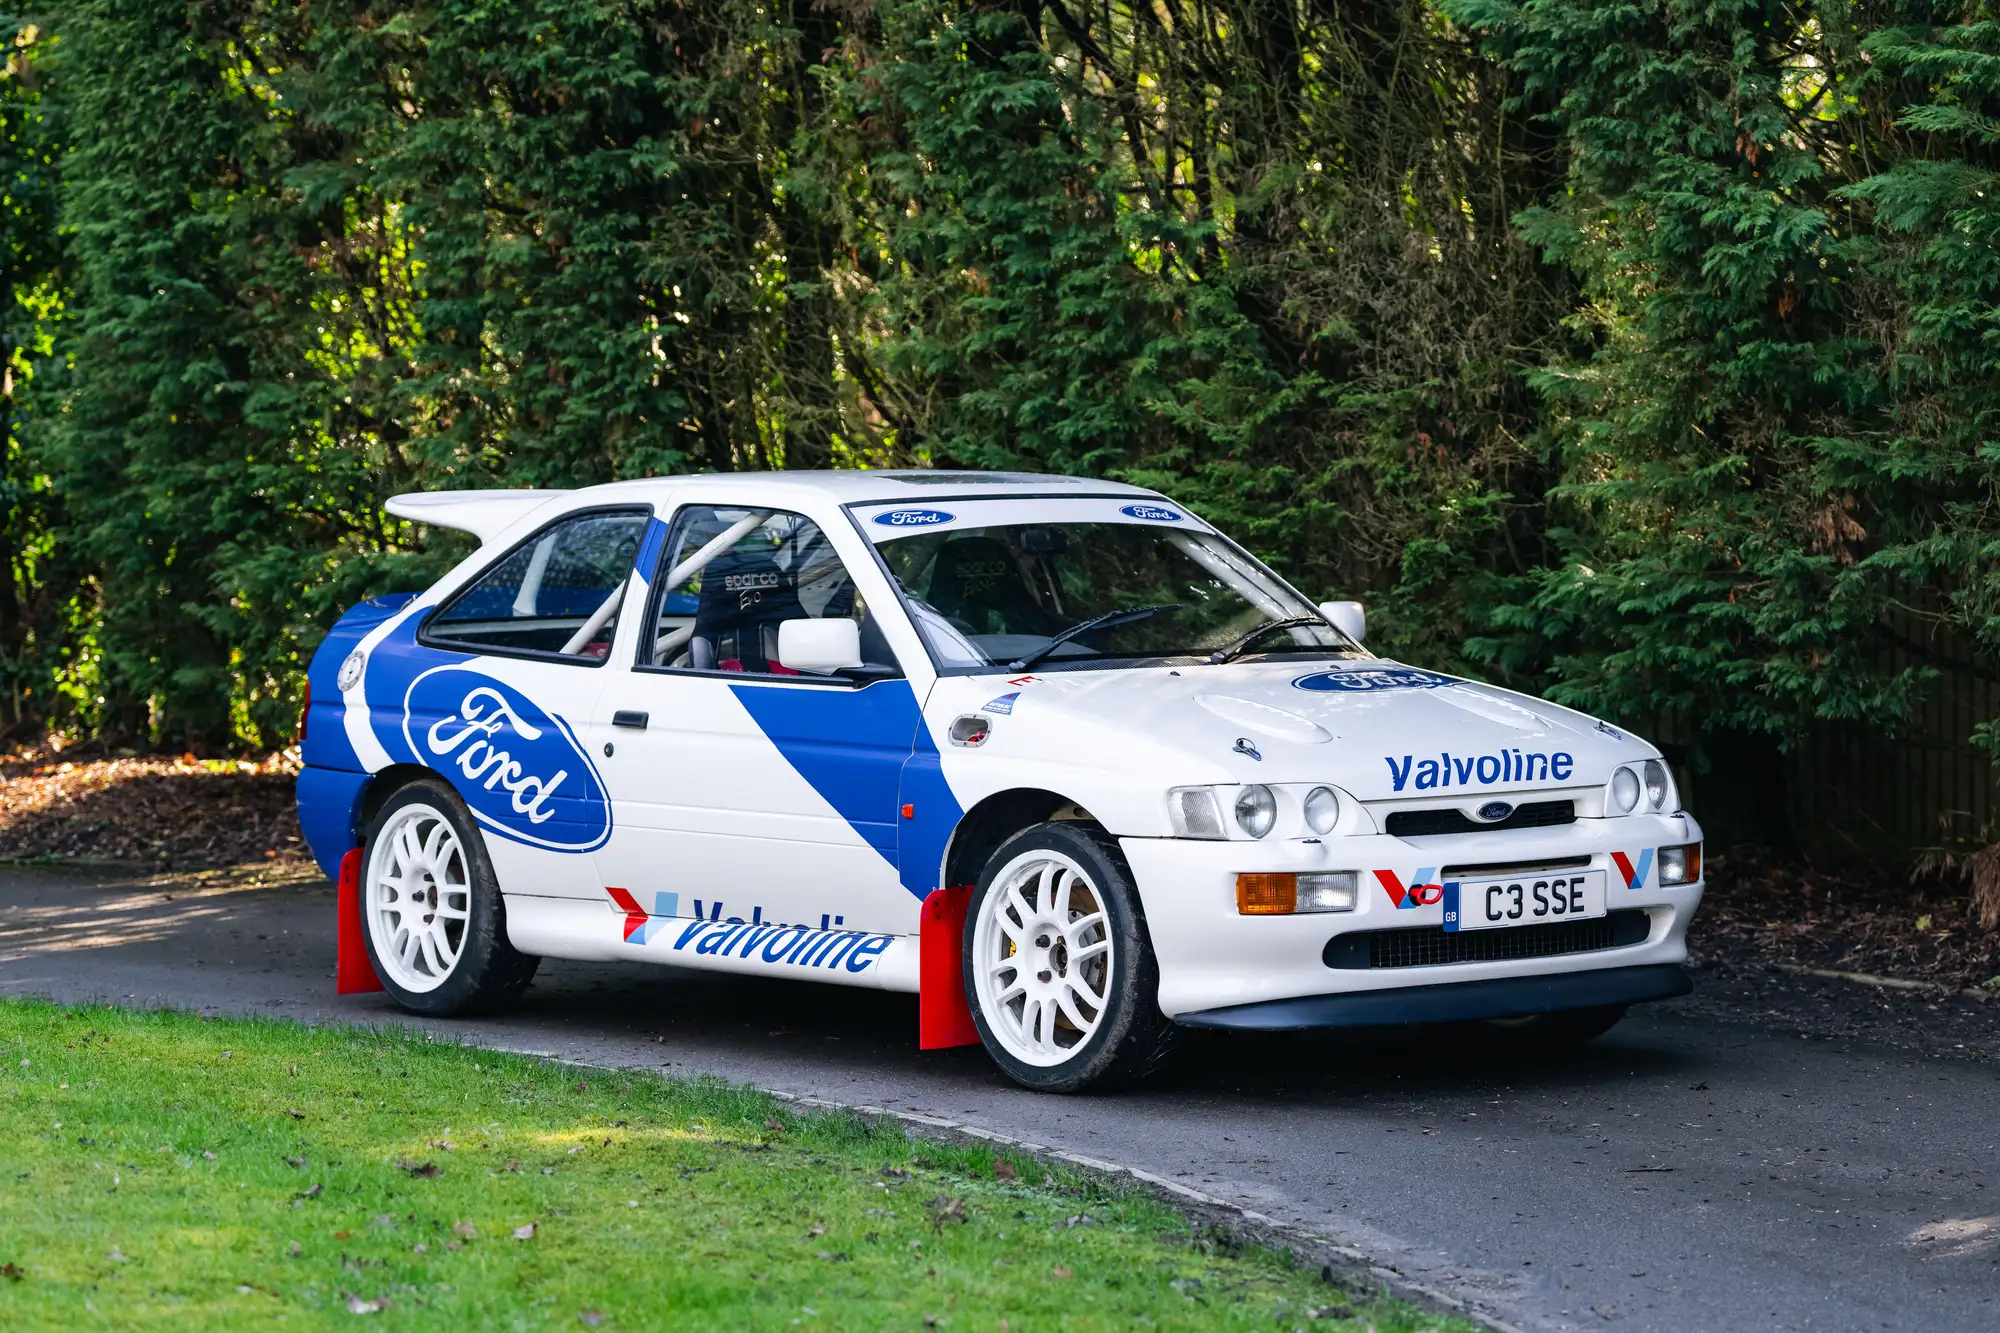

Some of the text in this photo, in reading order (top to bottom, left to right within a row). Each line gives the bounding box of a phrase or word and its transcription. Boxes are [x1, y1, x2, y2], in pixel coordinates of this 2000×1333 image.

[890, 511, 941, 525] Ford
[1132, 506, 1173, 520] Ford
[724, 572, 778, 591] sparco
[1327, 671, 1443, 689] Ford
[427, 686, 568, 824] Ford
[1384, 748, 1574, 792] Valvoline
[1485, 876, 1585, 922] C3 SSE
[1444, 911, 1458, 923] GB
[672, 898, 896, 973] Valvoline
